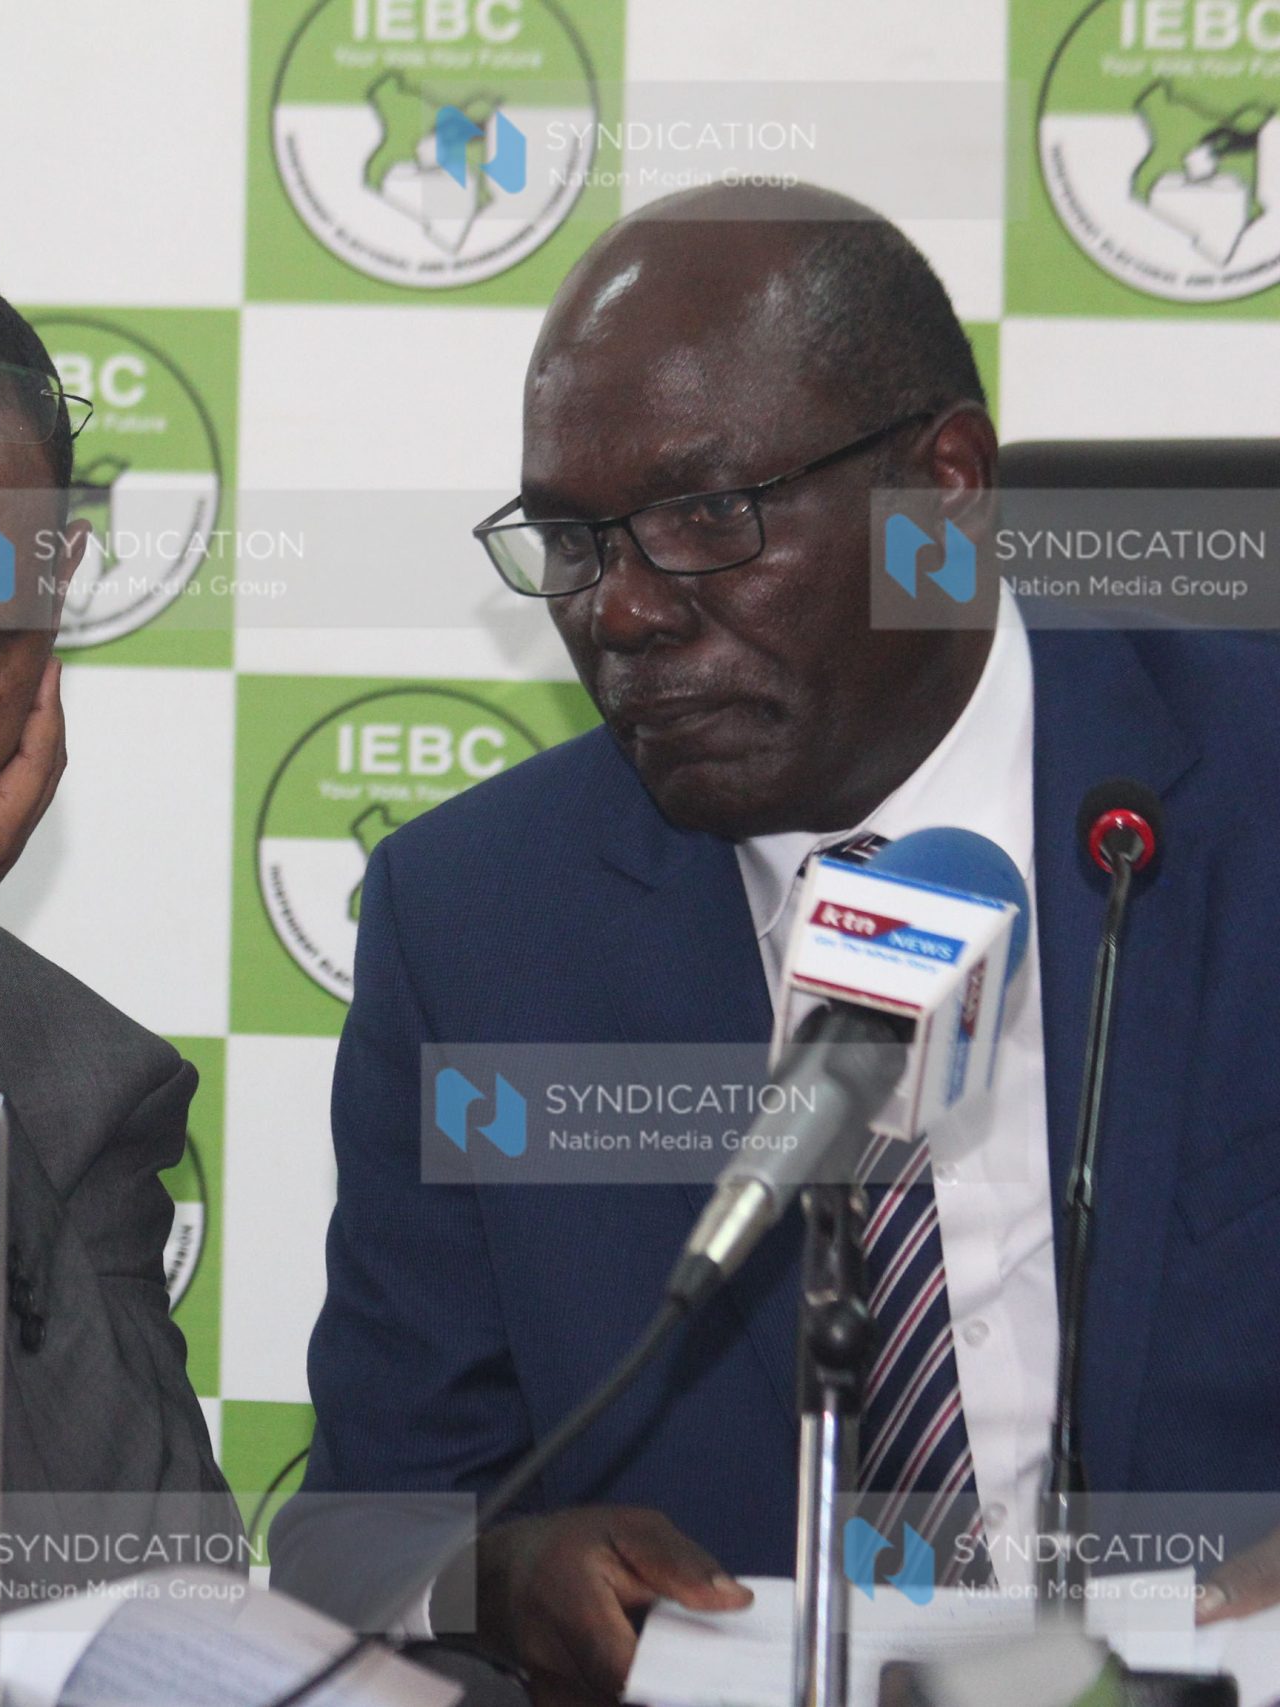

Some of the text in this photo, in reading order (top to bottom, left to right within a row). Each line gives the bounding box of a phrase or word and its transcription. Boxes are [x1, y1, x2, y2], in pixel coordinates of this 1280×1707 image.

[354, 0, 521, 41] IEBC
[1121, 0, 1280, 49] IEBC
[54, 352, 147, 408] BC
[338, 724, 506, 778] IEBC
[821, 904, 877, 936] ktn
[888, 930, 954, 960] NEWS
